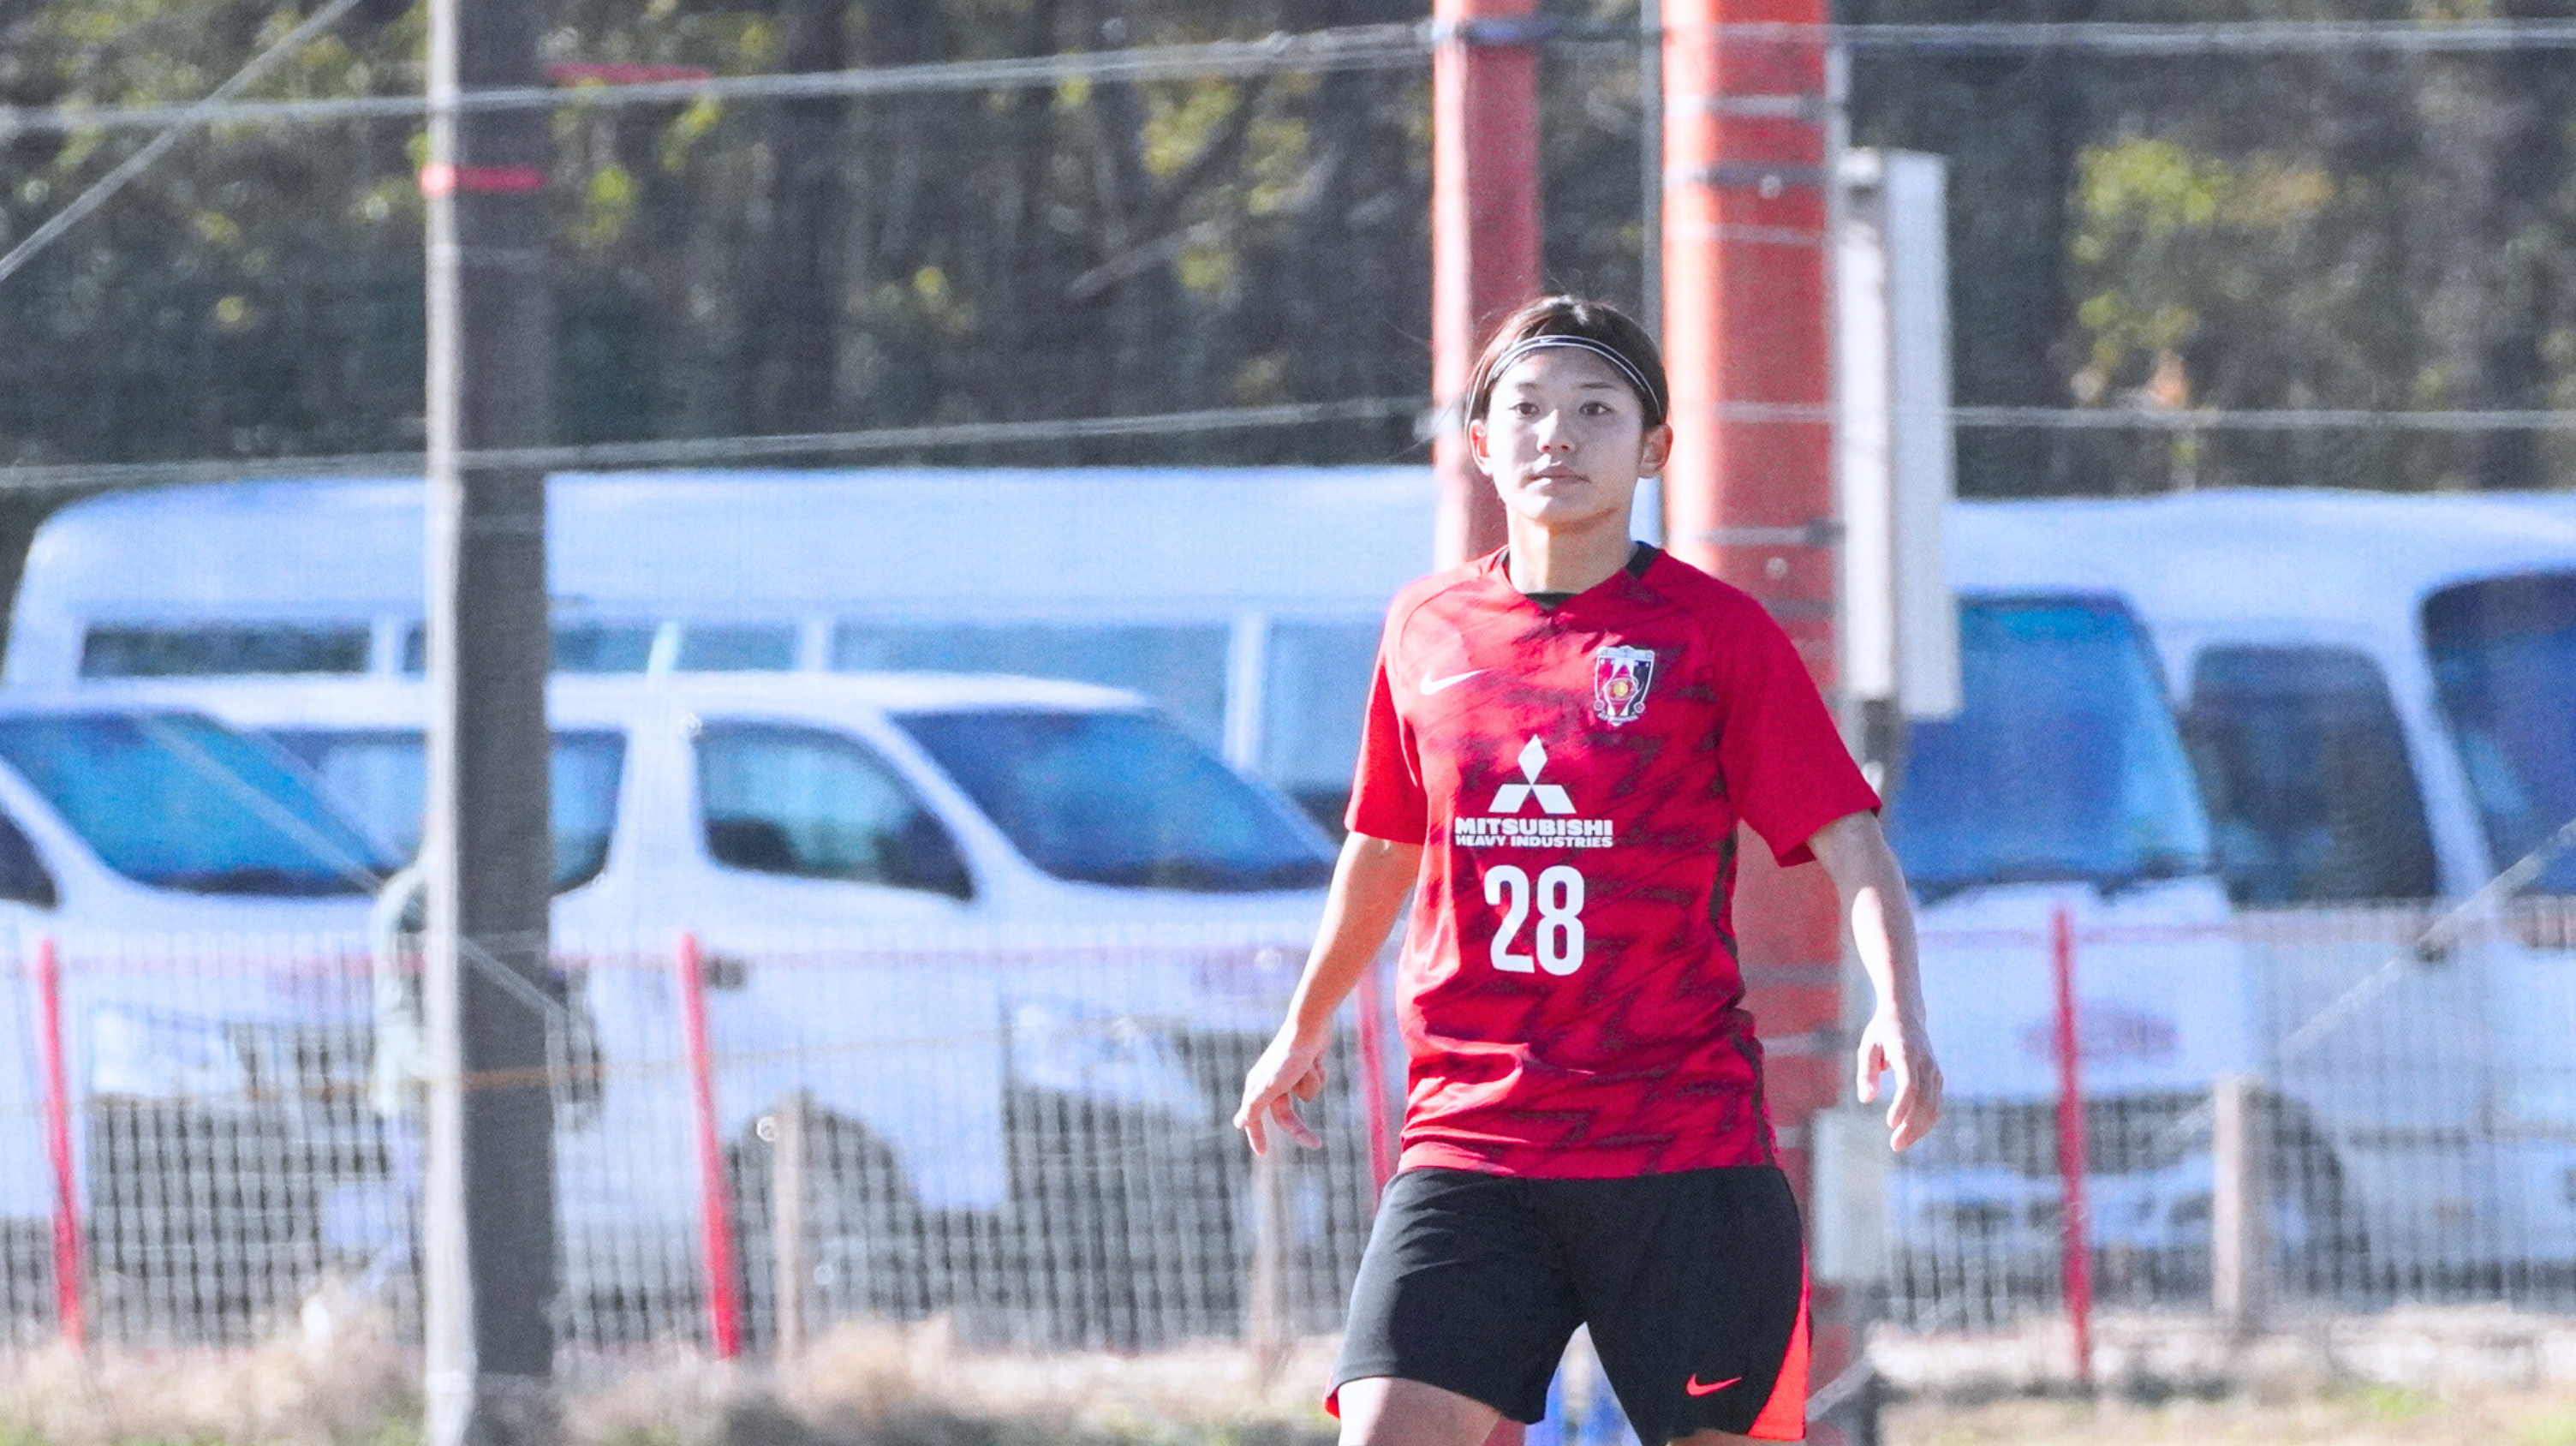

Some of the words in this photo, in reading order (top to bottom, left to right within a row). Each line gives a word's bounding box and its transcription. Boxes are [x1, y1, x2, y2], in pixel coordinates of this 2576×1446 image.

[1455, 817, 1613, 837] MITSUBISHI
[1456, 834, 1506, 846] HEAVY
[1511, 835, 1613, 848] INDUSTRIES
[1484, 864, 1584, 976] 28
